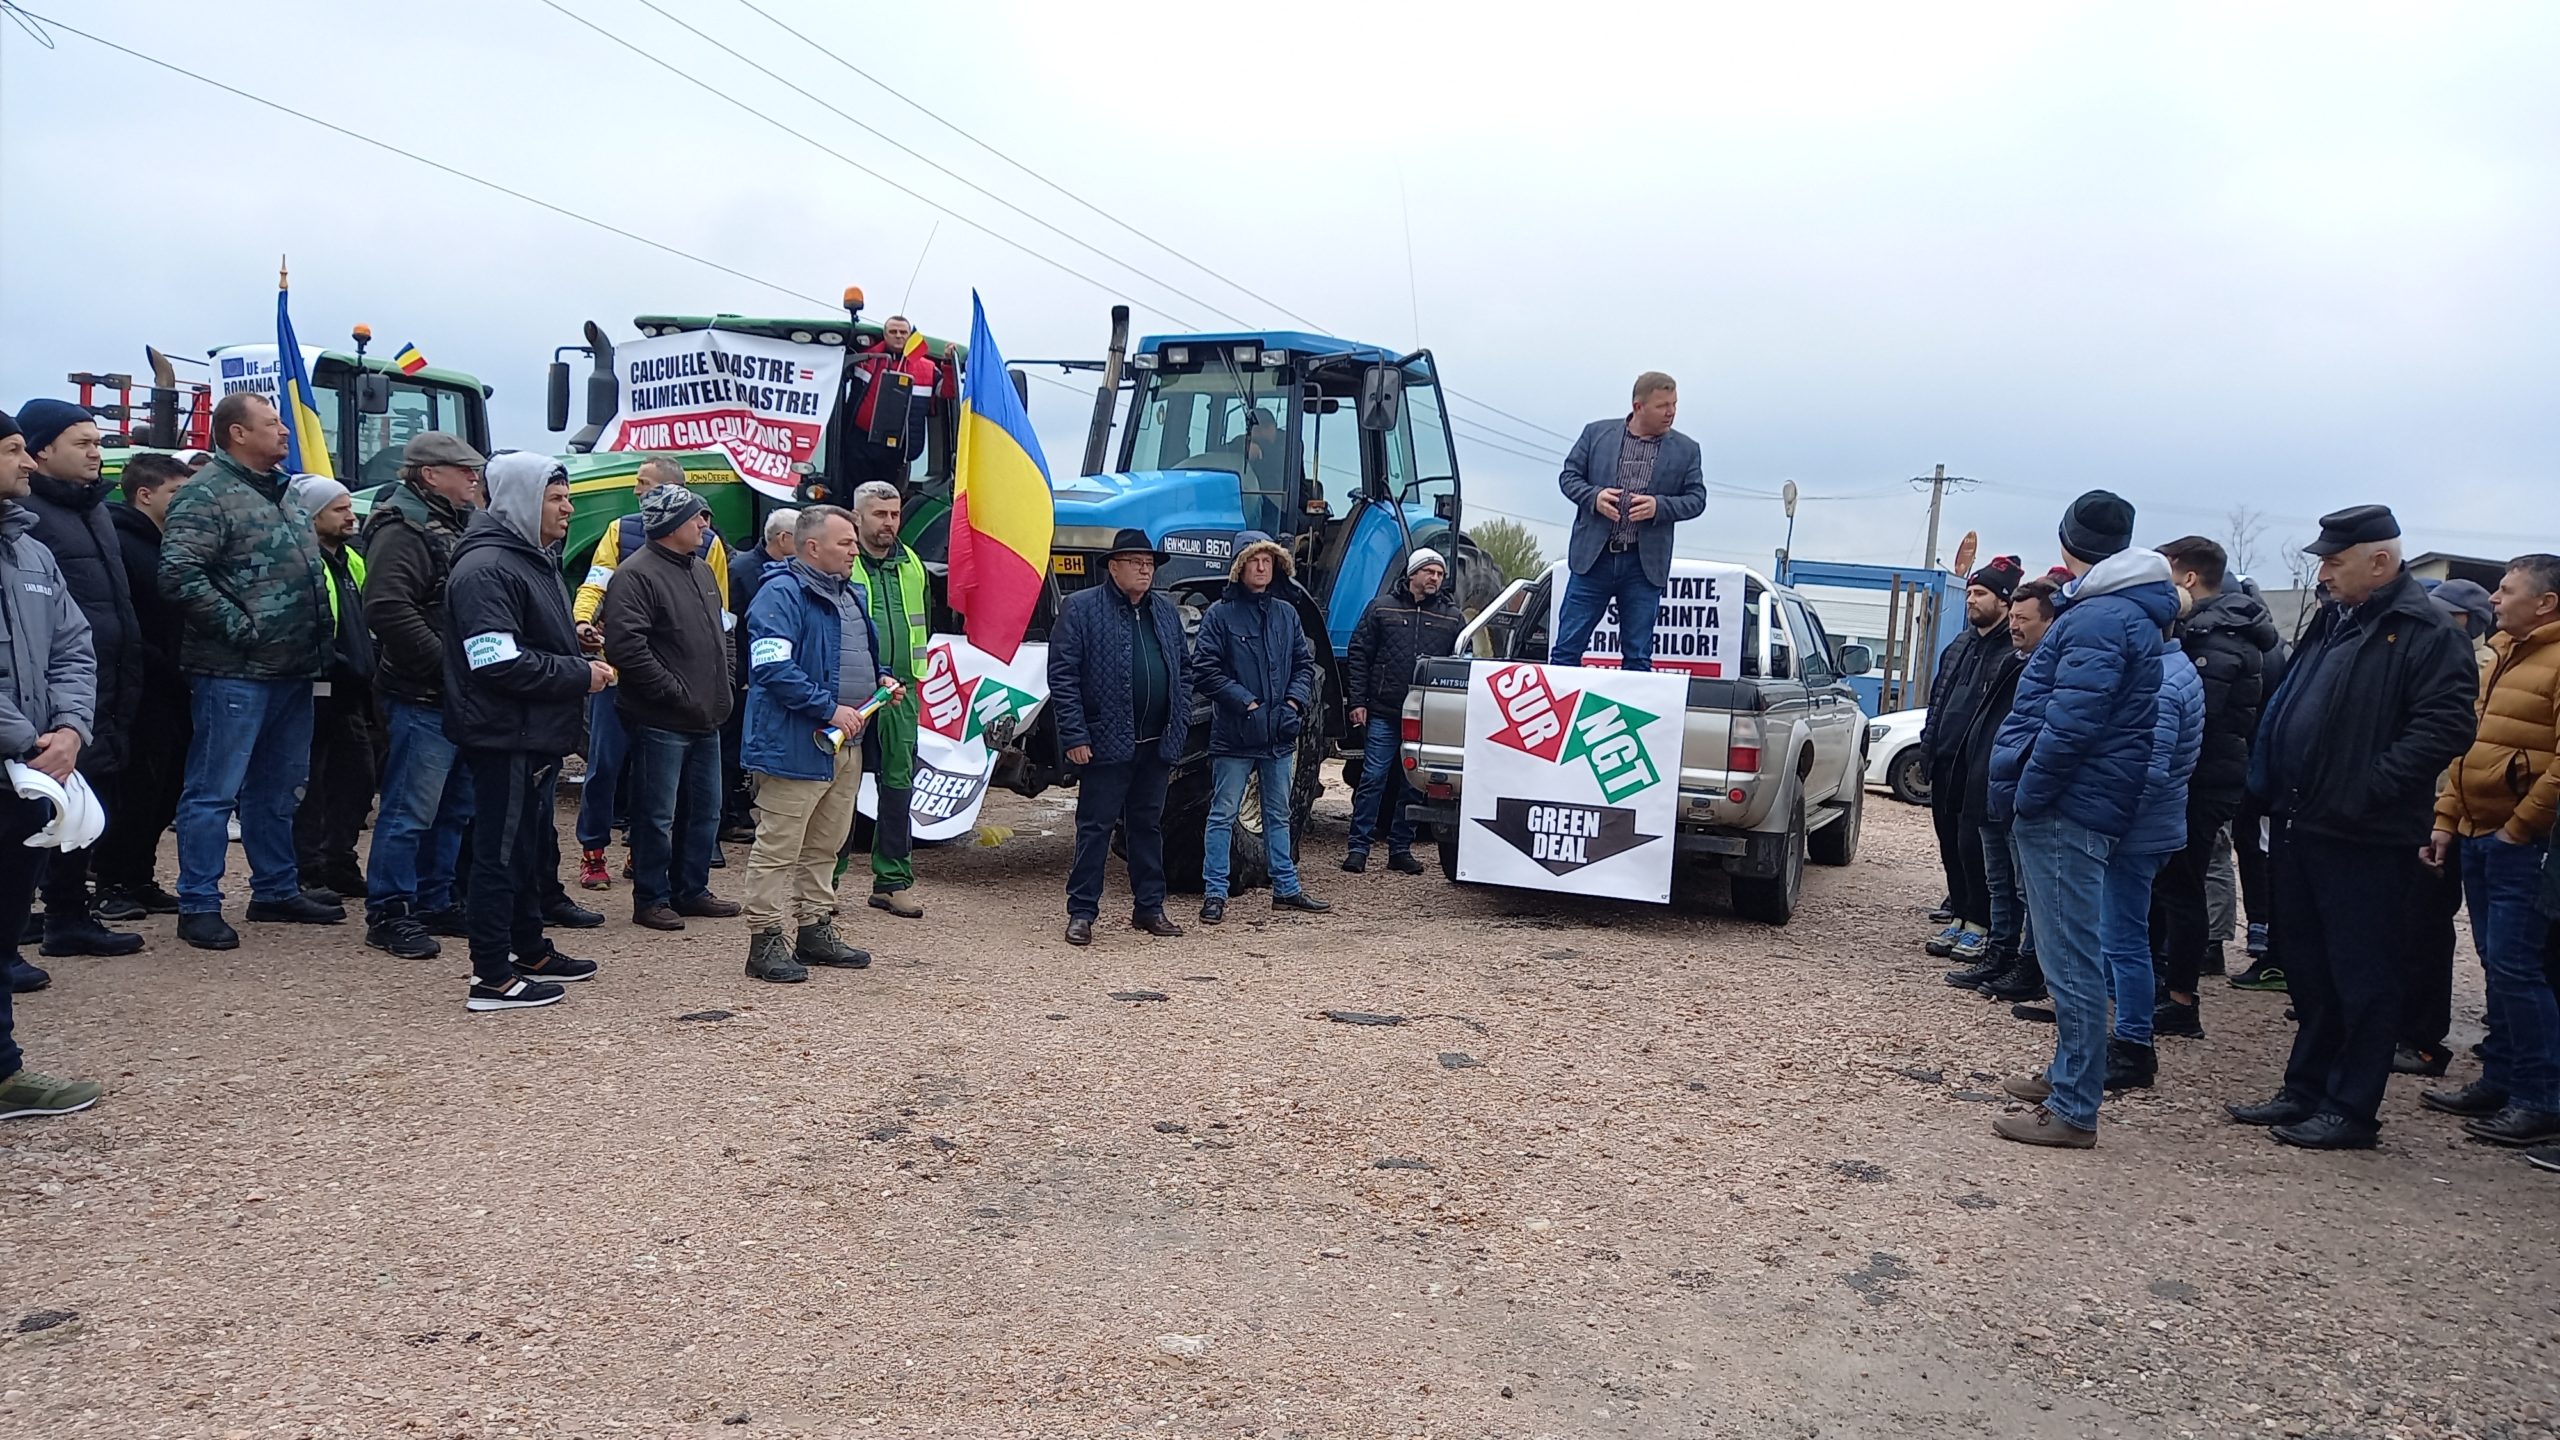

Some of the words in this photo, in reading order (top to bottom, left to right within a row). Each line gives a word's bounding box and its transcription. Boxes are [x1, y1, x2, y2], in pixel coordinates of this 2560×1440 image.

[246, 361, 258, 375] UE
[630, 351, 709, 384] CALCULELE
[224, 376, 276, 395] ROMANIA
[631, 379, 732, 412] FALIMENTELE
[630, 423, 671, 449] YOUR
[689, 473, 707, 482] JOHN
[708, 472, 729, 482] DEERE
[1164, 536, 1177, 551] NEW
[1177, 537, 1201, 553] HOLLAND
[1206, 538, 1231, 556] 8670
[1051, 557, 1082, 571] -BH
[1205, 560, 1221, 569] FORD
[921, 650, 963, 729] SUR
[1496, 665, 1561, 750] SUR
[1576, 704, 1654, 794] NGT
[913, 767, 978, 799] GREEN
[910, 792, 959, 818] DEAL
[1527, 805, 1600, 838] GREEN
[1532, 836, 1588, 864] DEAL
